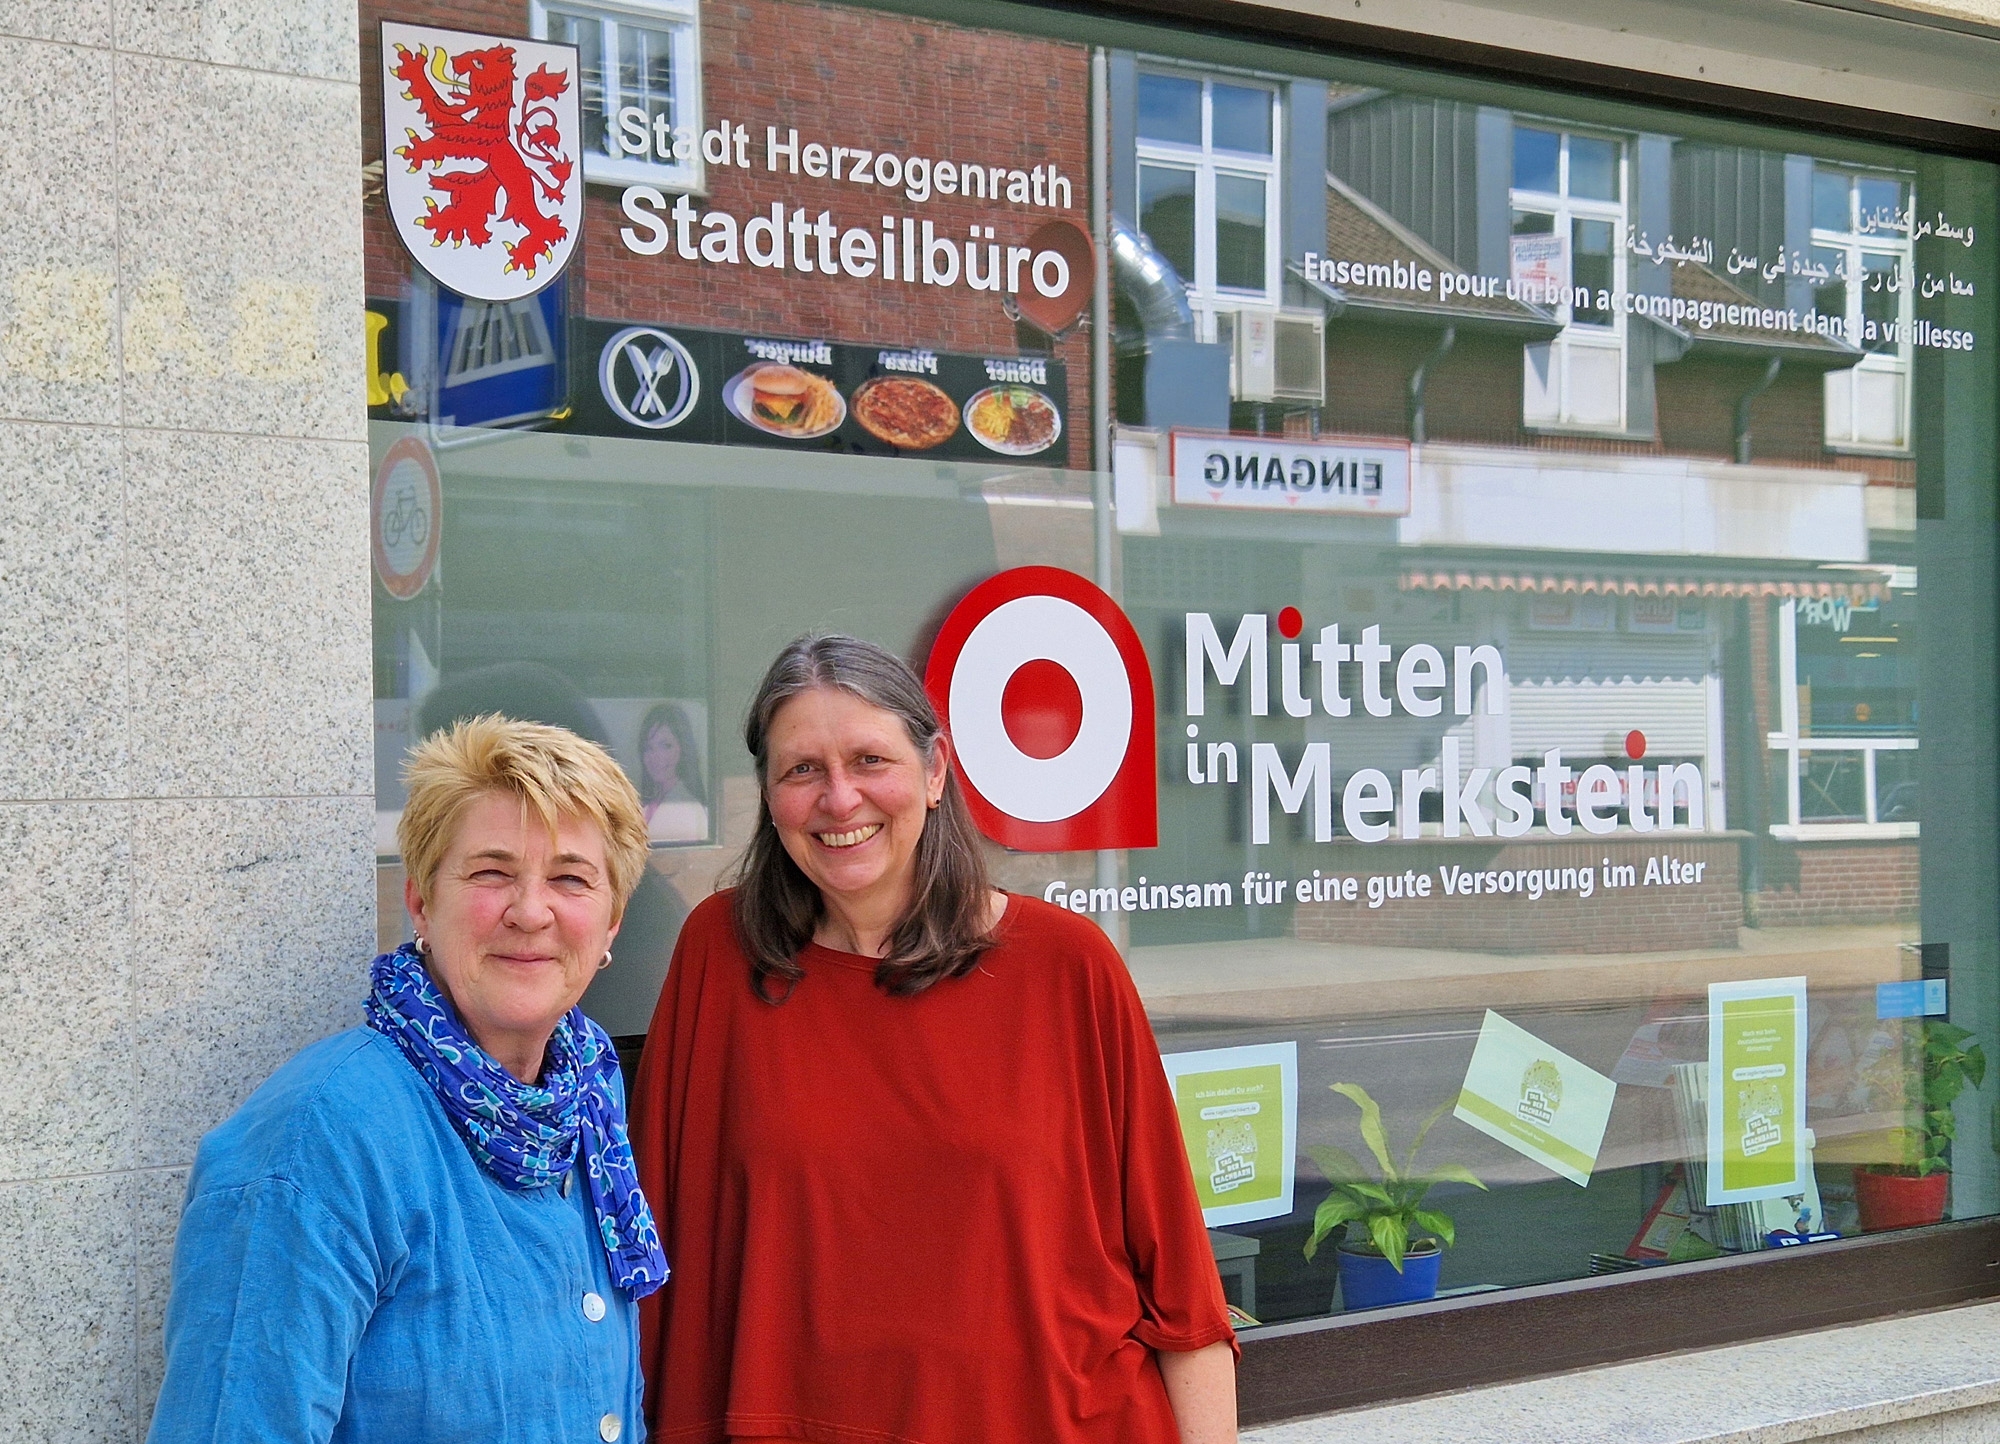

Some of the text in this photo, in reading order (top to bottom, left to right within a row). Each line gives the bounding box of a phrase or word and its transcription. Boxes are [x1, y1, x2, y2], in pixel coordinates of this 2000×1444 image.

[618, 106, 1072, 209] Stadt Herzogenrath
[621, 186, 1070, 298] Stadtteilbüro
[1626, 225, 1712, 267] الشيخوخة
[1934, 211, 1974, 247] وسط
[1726, 248, 1757, 275] سن
[1763, 245, 1786, 284] في
[1791, 250, 1829, 285] جيدة
[1921, 272, 1945, 299] من
[1949, 271, 1974, 297] معا
[1304, 252, 1974, 351] Ensemble pour un bon accompagnement dans la vieillesse
[1185, 607, 1504, 718] Mitten
[1186, 724, 1238, 784] in
[1252, 730, 1704, 845] Merkstein
[1044, 855, 1706, 913] Gemeinsam für eine gute Versorgung im Alter
